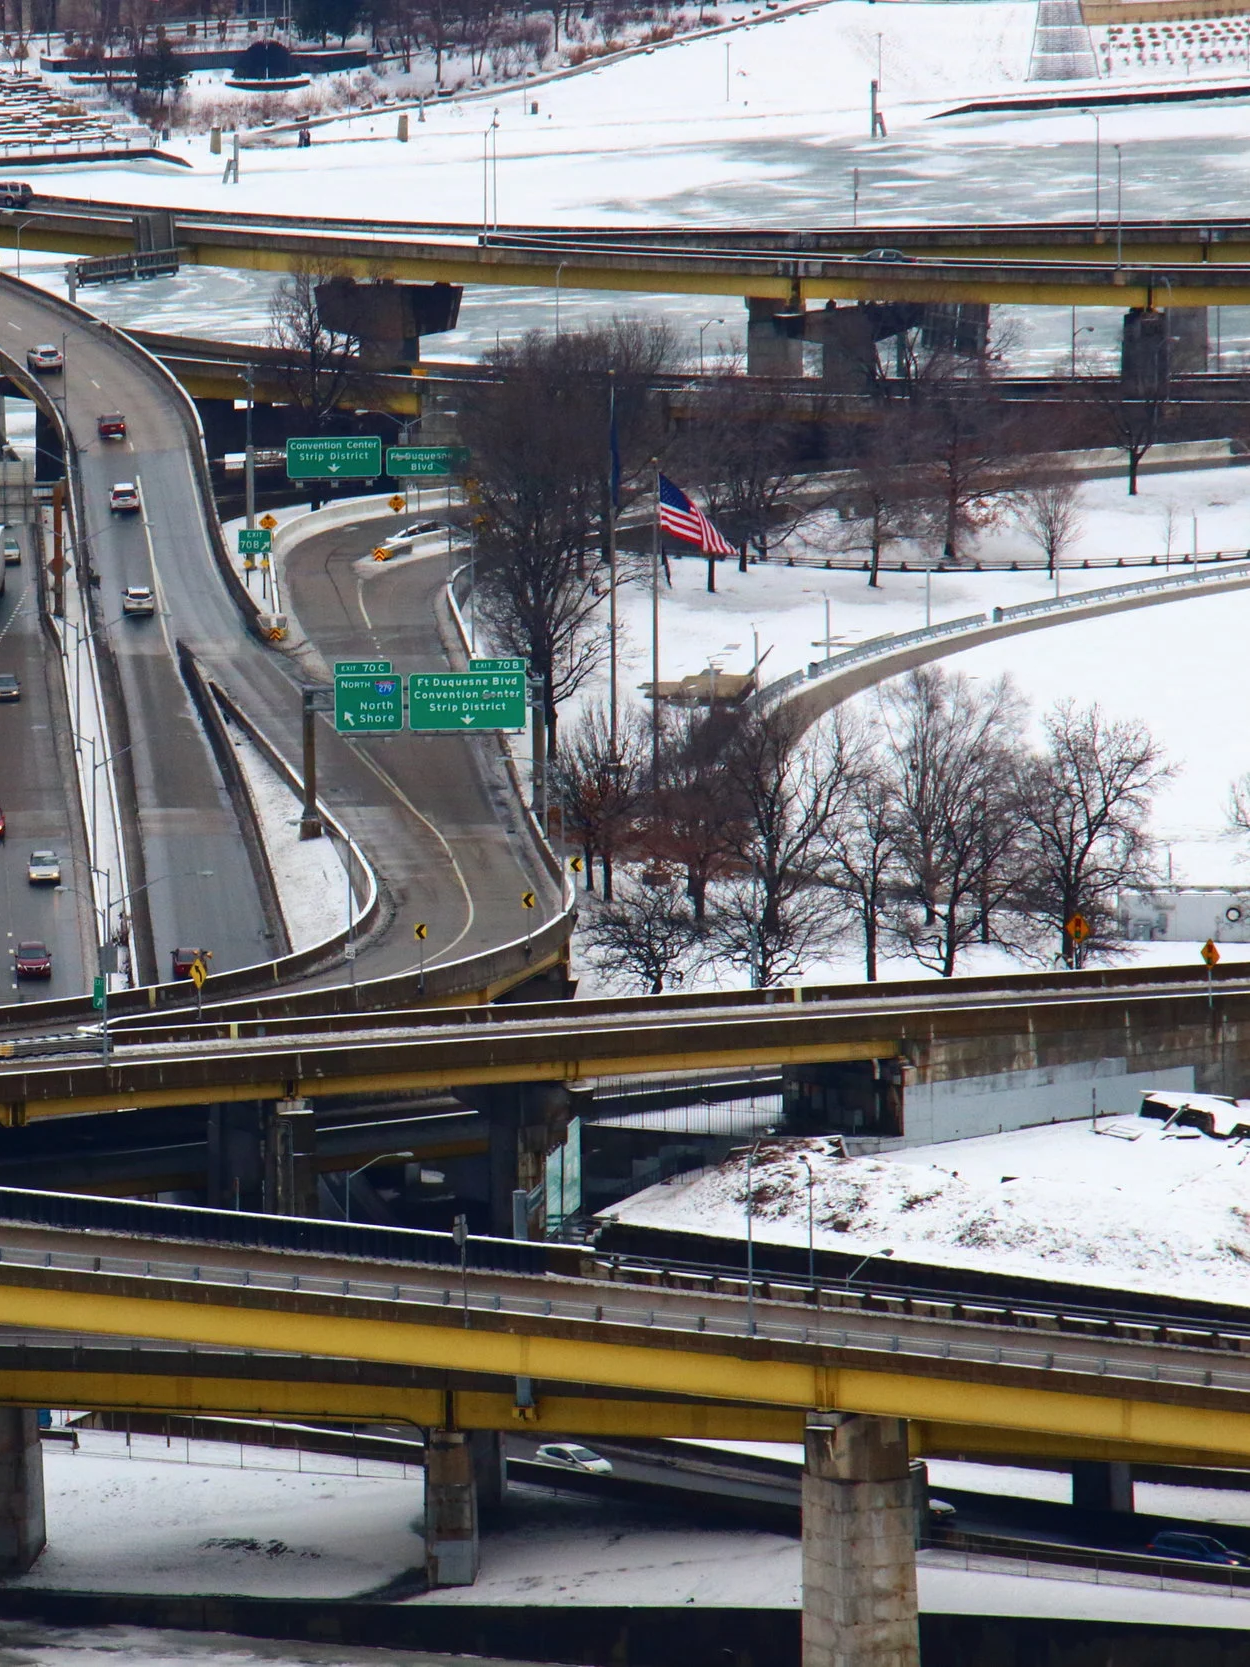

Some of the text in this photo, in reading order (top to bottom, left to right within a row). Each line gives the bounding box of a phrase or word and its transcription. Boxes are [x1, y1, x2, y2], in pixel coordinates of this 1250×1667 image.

[290, 440, 377, 450] Convention Center
[300, 452, 369, 462] Strip District
[411, 463, 434, 471] Blvd
[341, 680, 370, 688] NORTH
[433, 678, 488, 687] Duquesne
[492, 677, 517, 685] Blvd
[379, 684, 392, 692] 279
[414, 690, 478, 699] Convention
[360, 701, 393, 710] North
[430, 702, 506, 712] Strip District
[360, 714, 394, 723] Shore
